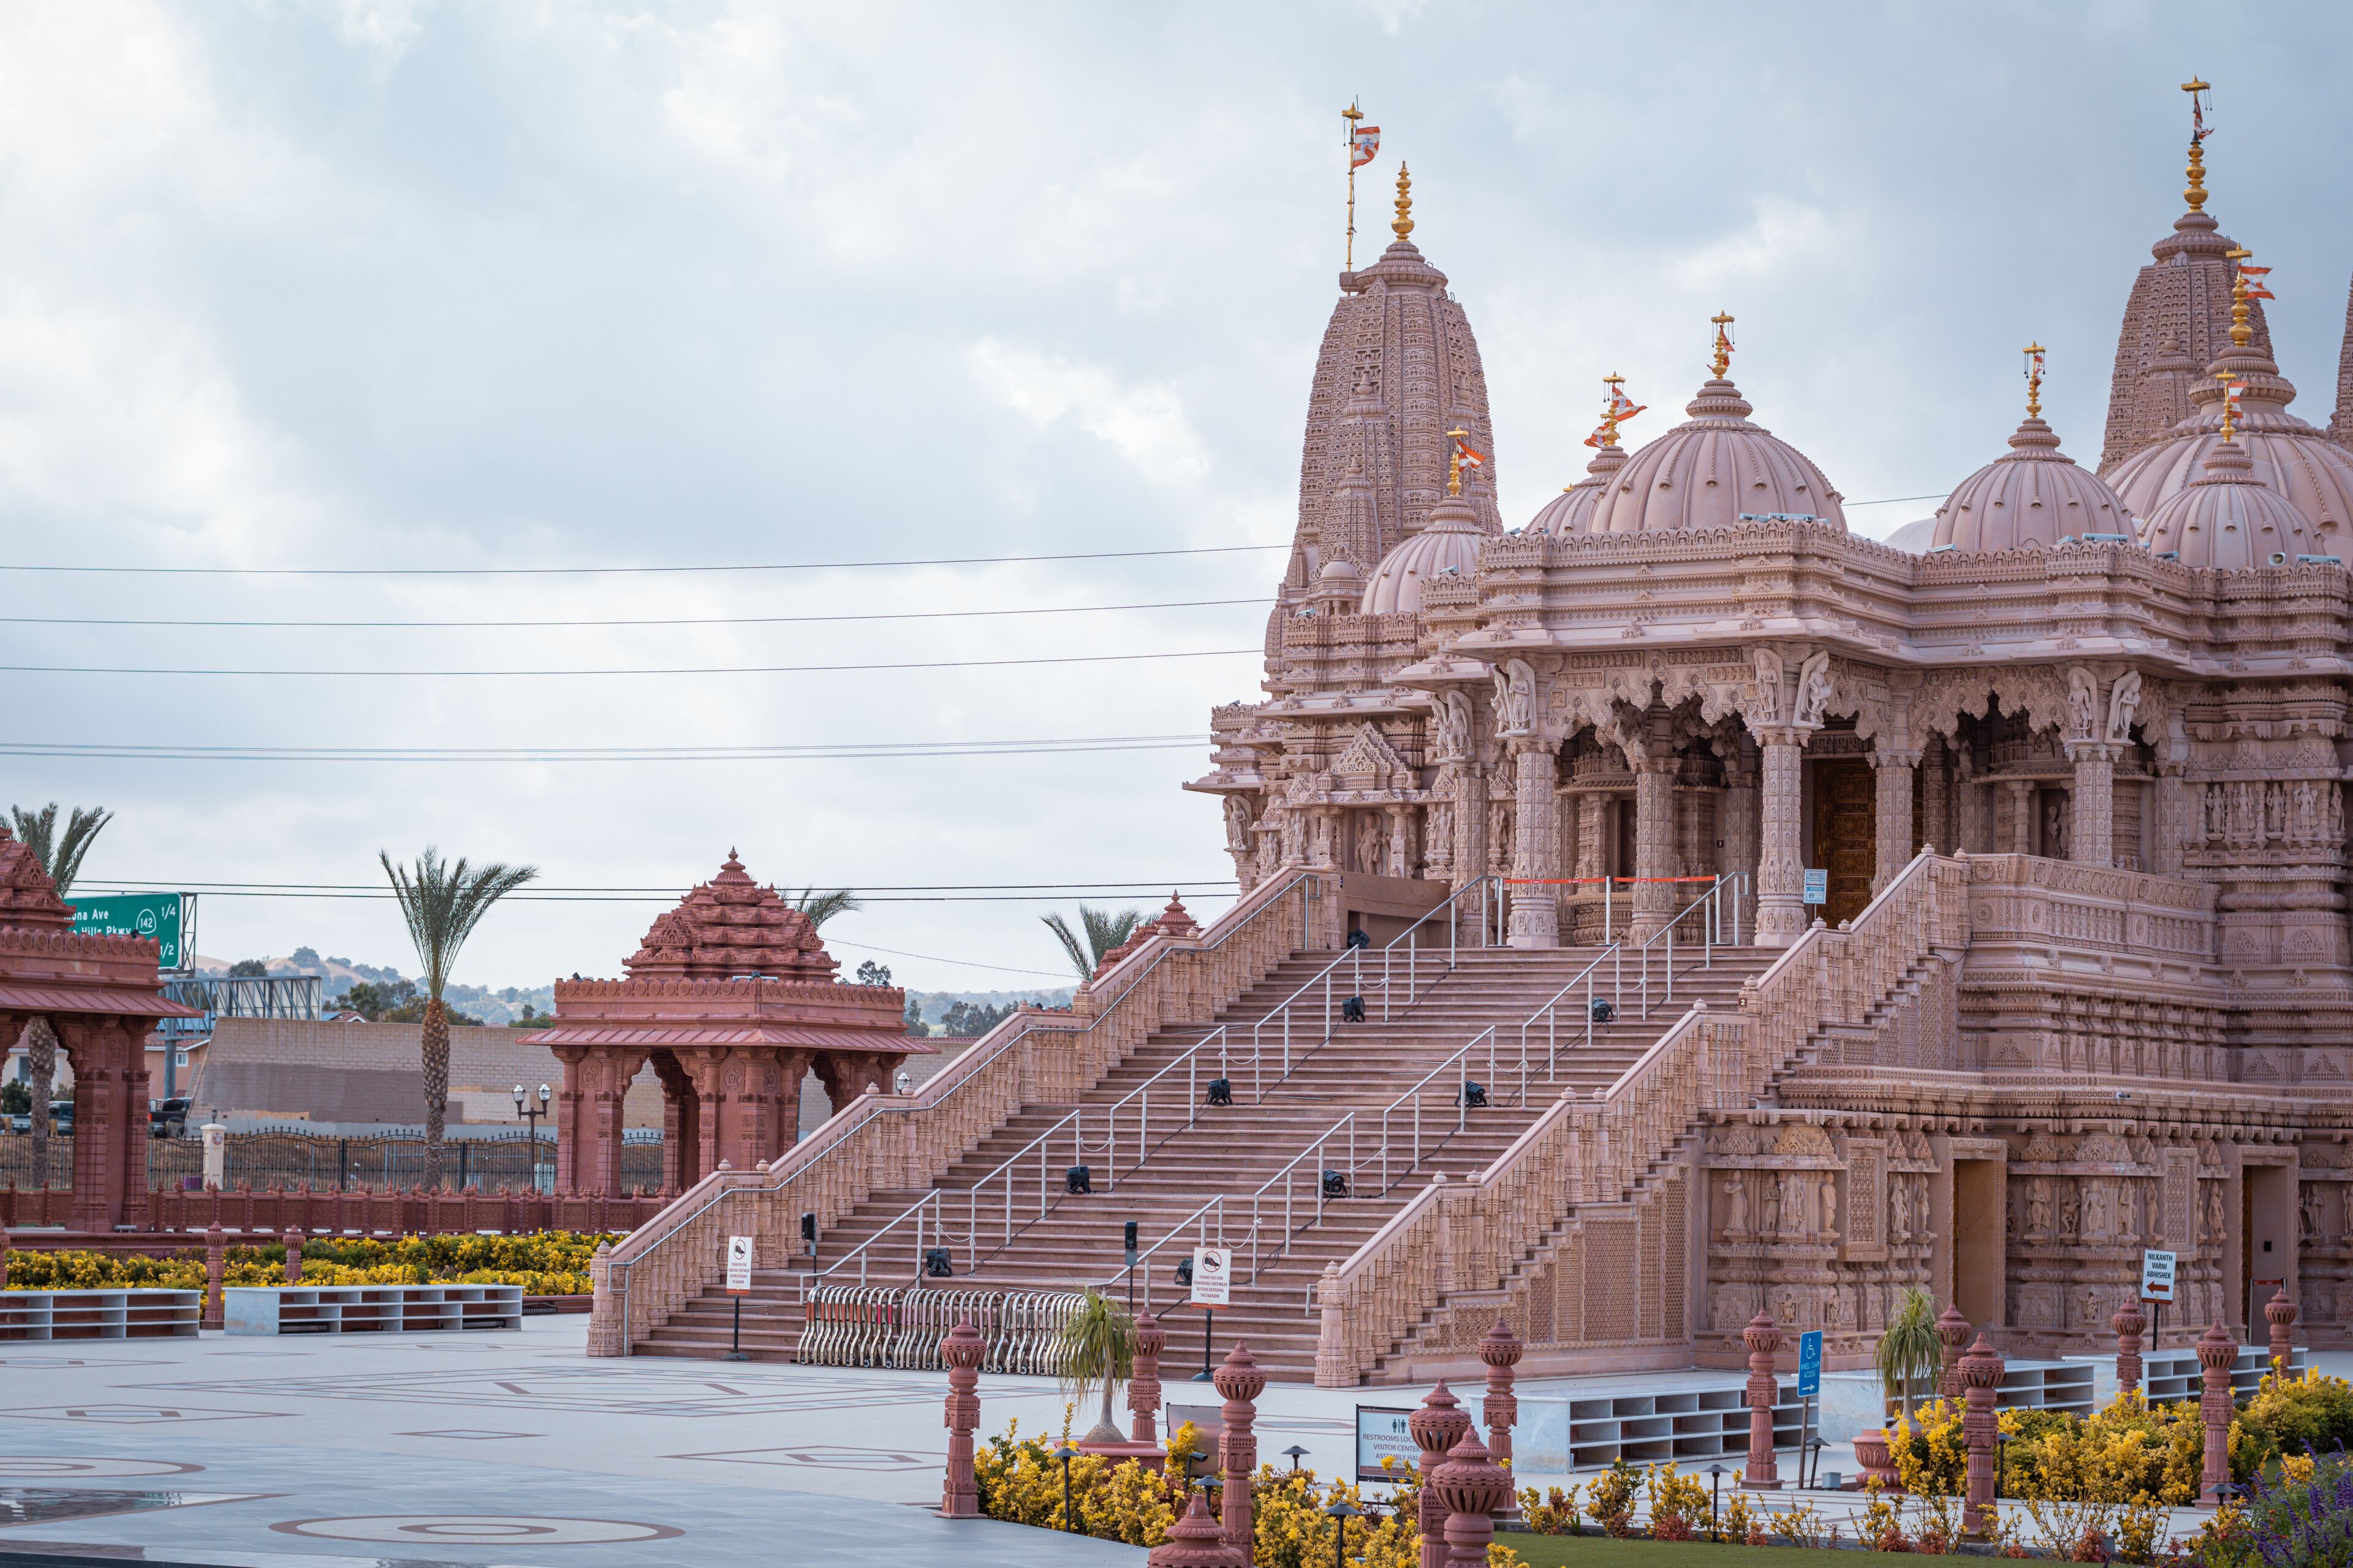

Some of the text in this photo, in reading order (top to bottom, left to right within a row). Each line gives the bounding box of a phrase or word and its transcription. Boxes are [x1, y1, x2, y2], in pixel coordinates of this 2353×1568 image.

[64, 903, 176, 920] ona Ave 1/4
[140, 917, 153, 928] 142
[160, 942, 173, 958] 1/2
